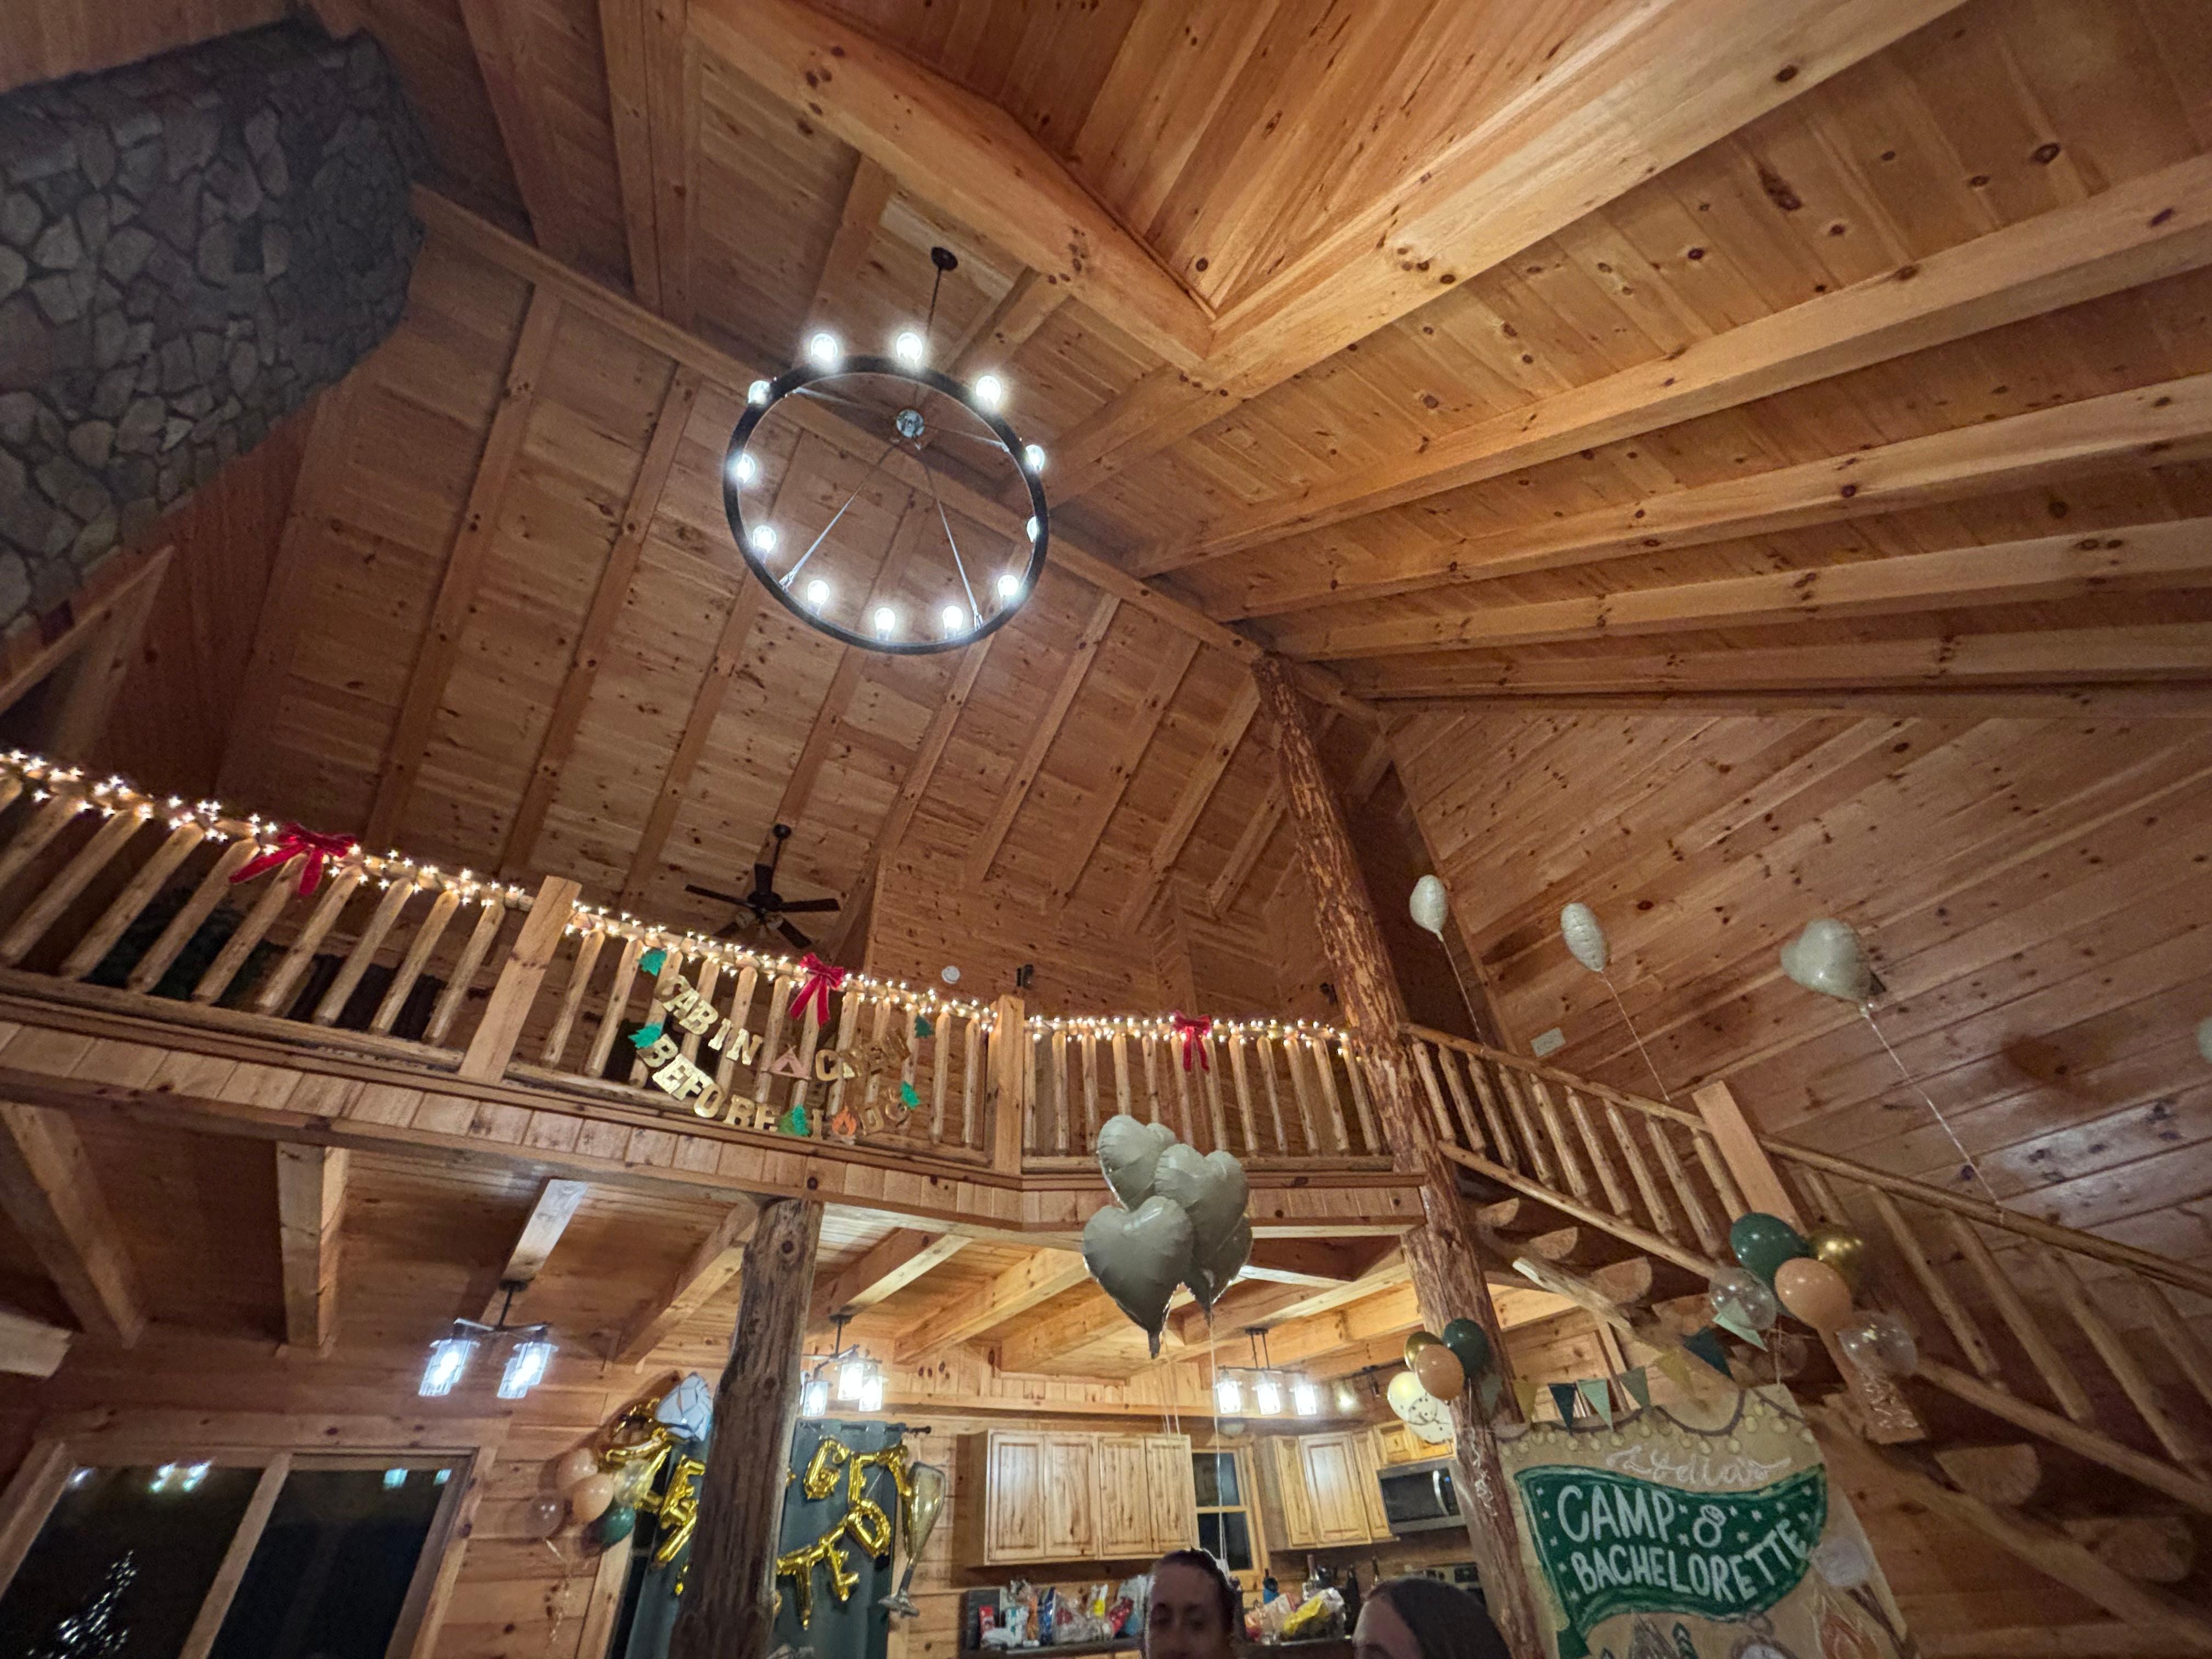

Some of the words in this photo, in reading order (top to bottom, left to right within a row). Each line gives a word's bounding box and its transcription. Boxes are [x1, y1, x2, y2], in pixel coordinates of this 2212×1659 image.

[656, 974, 763, 1065] CABIN
[637, 1033, 779, 1132] BEFORE
[1558, 1485, 1675, 1543] CAMP
[1571, 1519, 1808, 1604] BACHELORETTE
